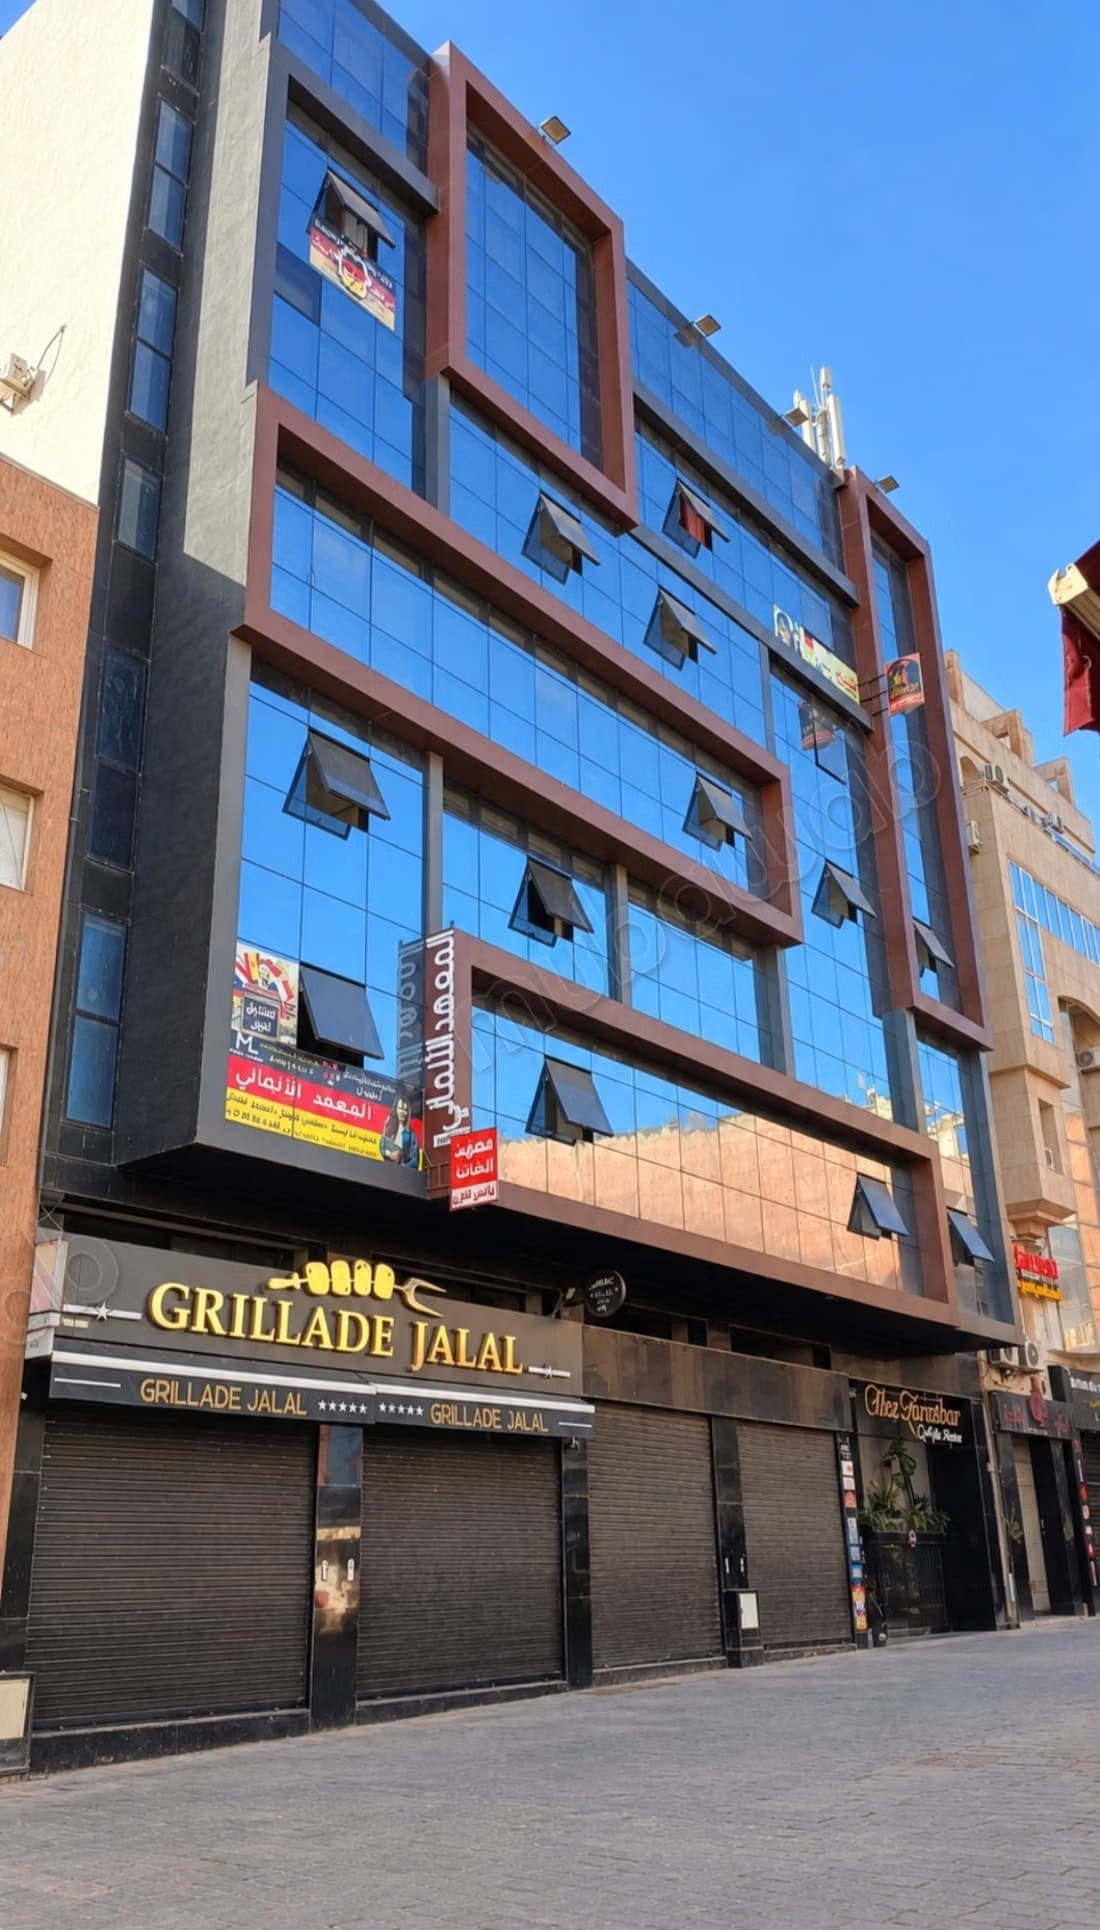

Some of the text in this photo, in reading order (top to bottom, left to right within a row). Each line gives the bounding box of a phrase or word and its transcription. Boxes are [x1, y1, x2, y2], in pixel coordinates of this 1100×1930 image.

[149, 1281, 396, 1358] GRILLADE
[410, 1320, 524, 1374] JALAL
[139, 1377, 307, 1417] GRILLADE JALAL
[430, 1402, 549, 1434] GRILLADE JALAL
